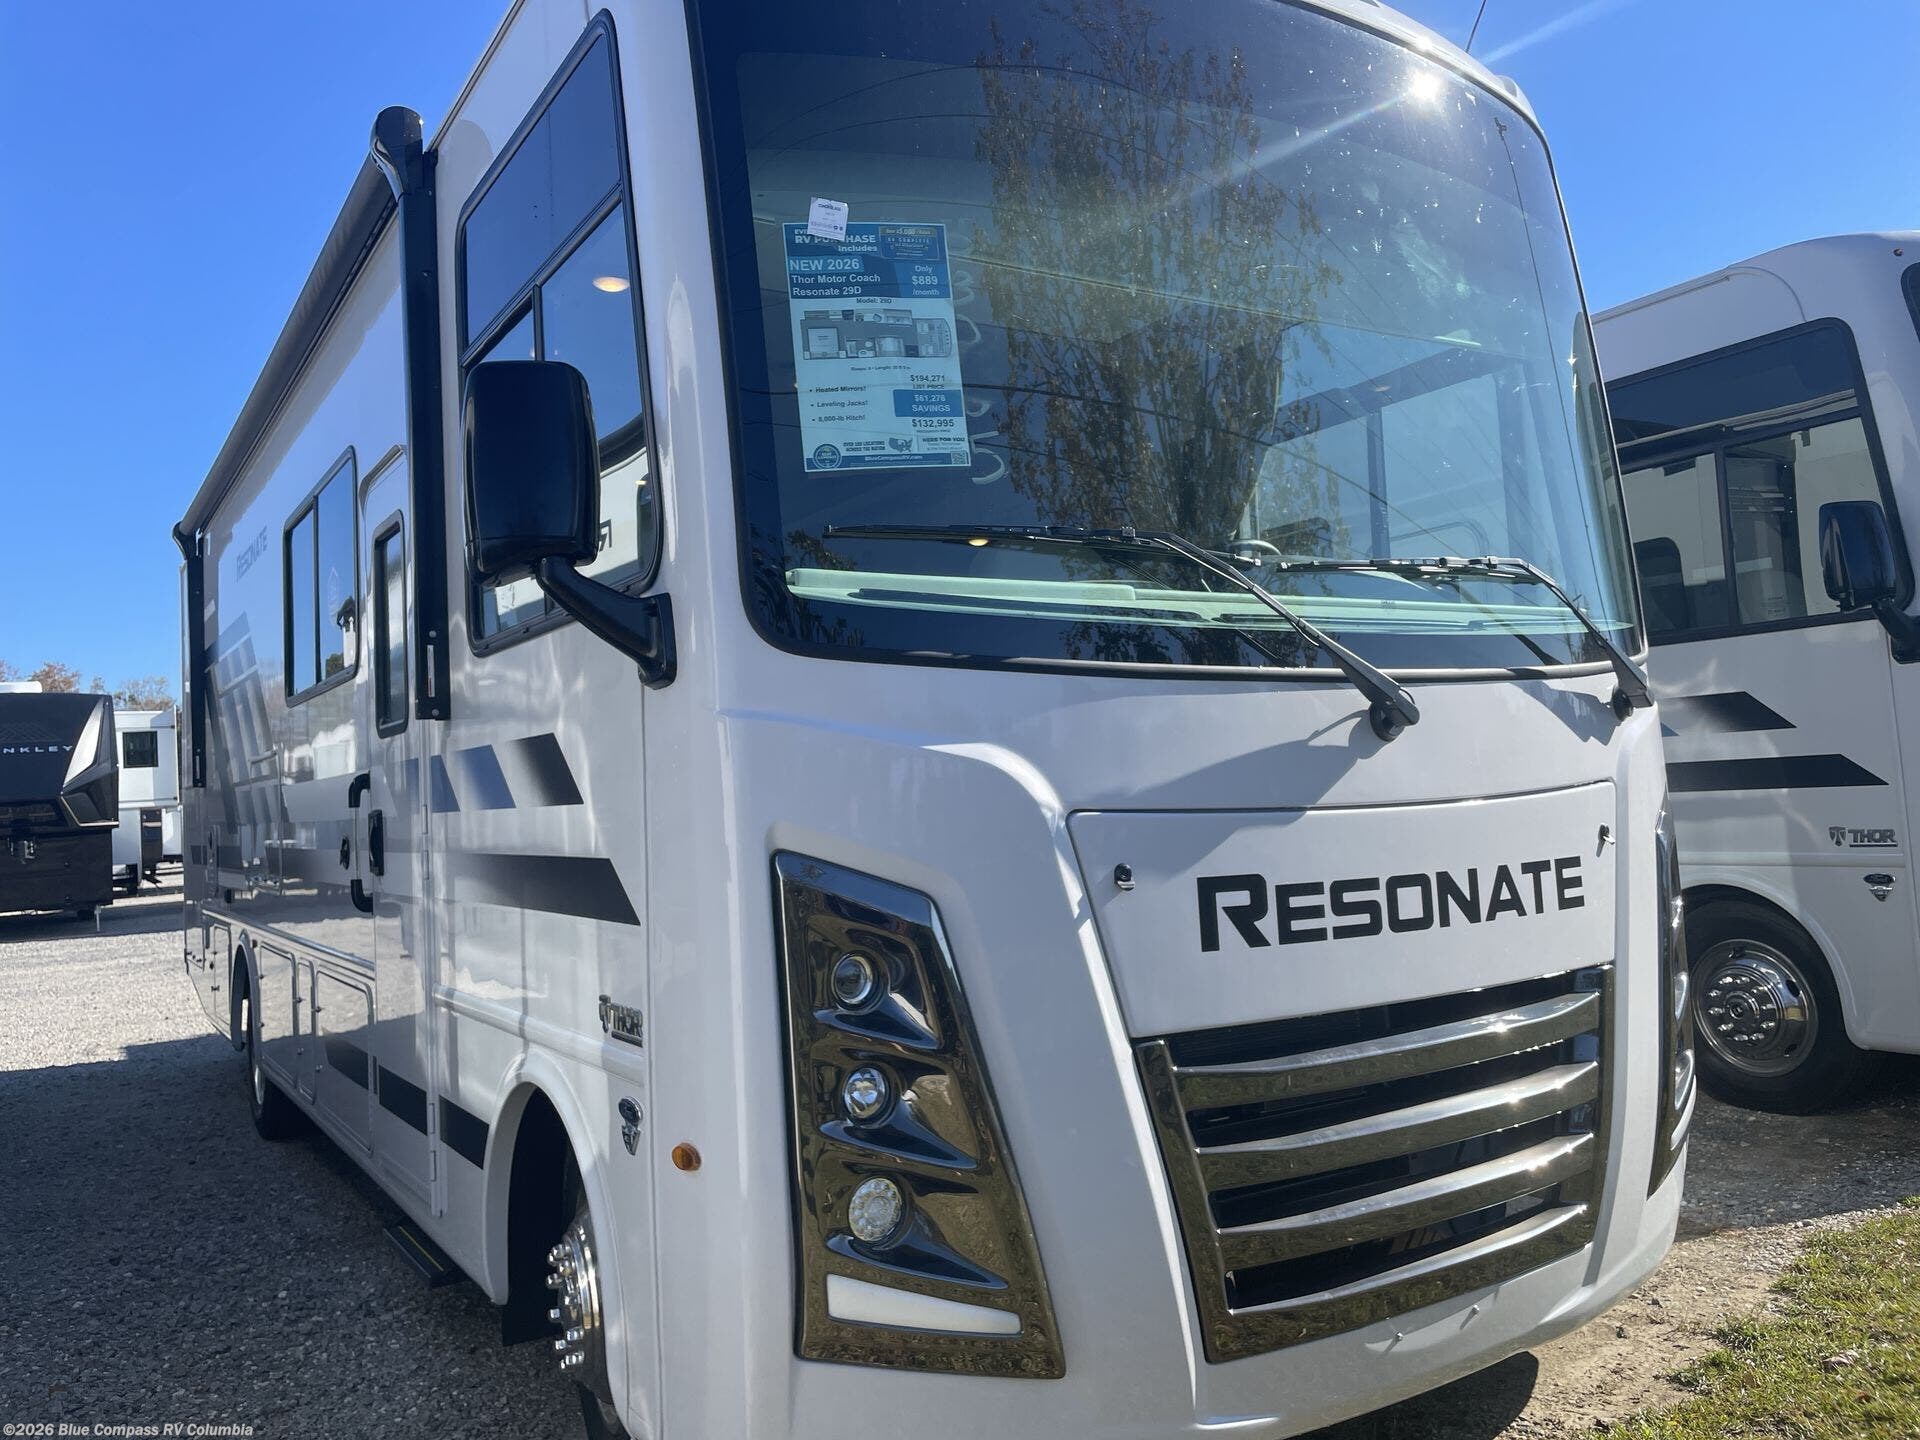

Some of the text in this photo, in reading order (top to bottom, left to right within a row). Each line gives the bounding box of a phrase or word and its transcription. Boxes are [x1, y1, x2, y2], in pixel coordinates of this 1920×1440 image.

[794, 235, 877, 244] RV PUHASE
[789, 258, 860, 271] NEW 2026
[914, 265, 933, 273] Only
[791, 273, 881, 284] Thor Motor Coach
[911, 275, 938, 285] $889
[793, 286, 862, 296] Resonate 29D
[912, 288, 940, 296] /month
[910, 374, 945, 382] $194,271
[911, 404, 951, 412] SAVINGS
[911, 418, 954, 428] $132,995
[1847, 829, 1897, 843] THOR
[1196, 855, 1585, 953] RESONATE
[609, 1002, 644, 1038] THOR
